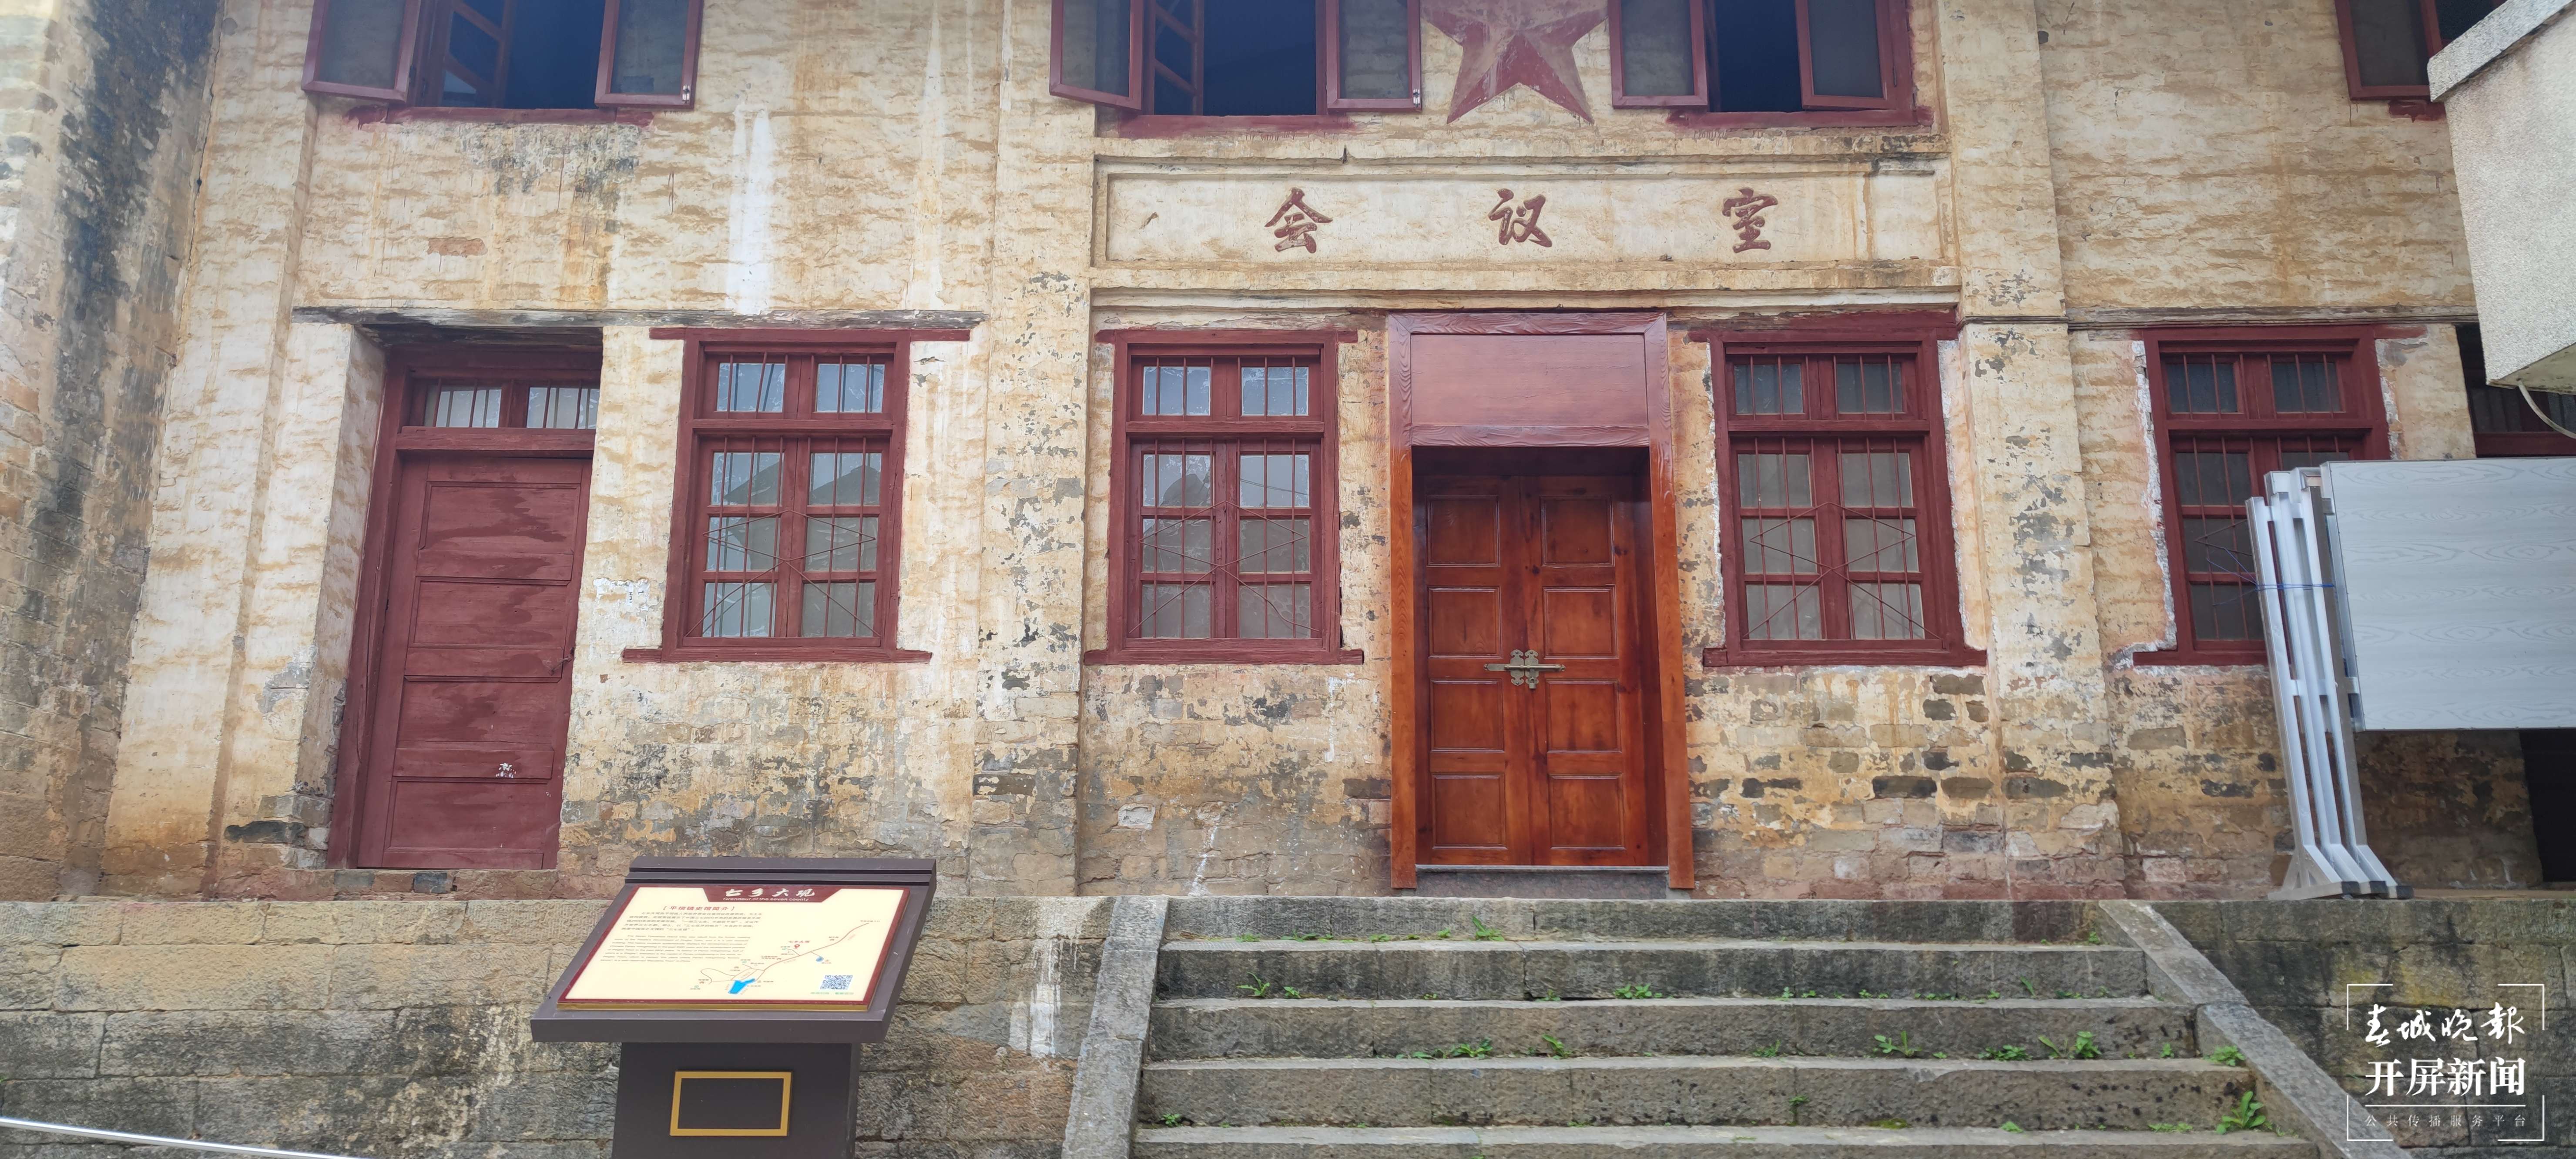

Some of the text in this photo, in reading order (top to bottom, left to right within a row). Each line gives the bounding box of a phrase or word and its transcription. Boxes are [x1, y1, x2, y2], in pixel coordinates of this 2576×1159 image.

[1264, 187, 1779, 253] 会议室
[725, 888, 815, 898] 七乡大观
